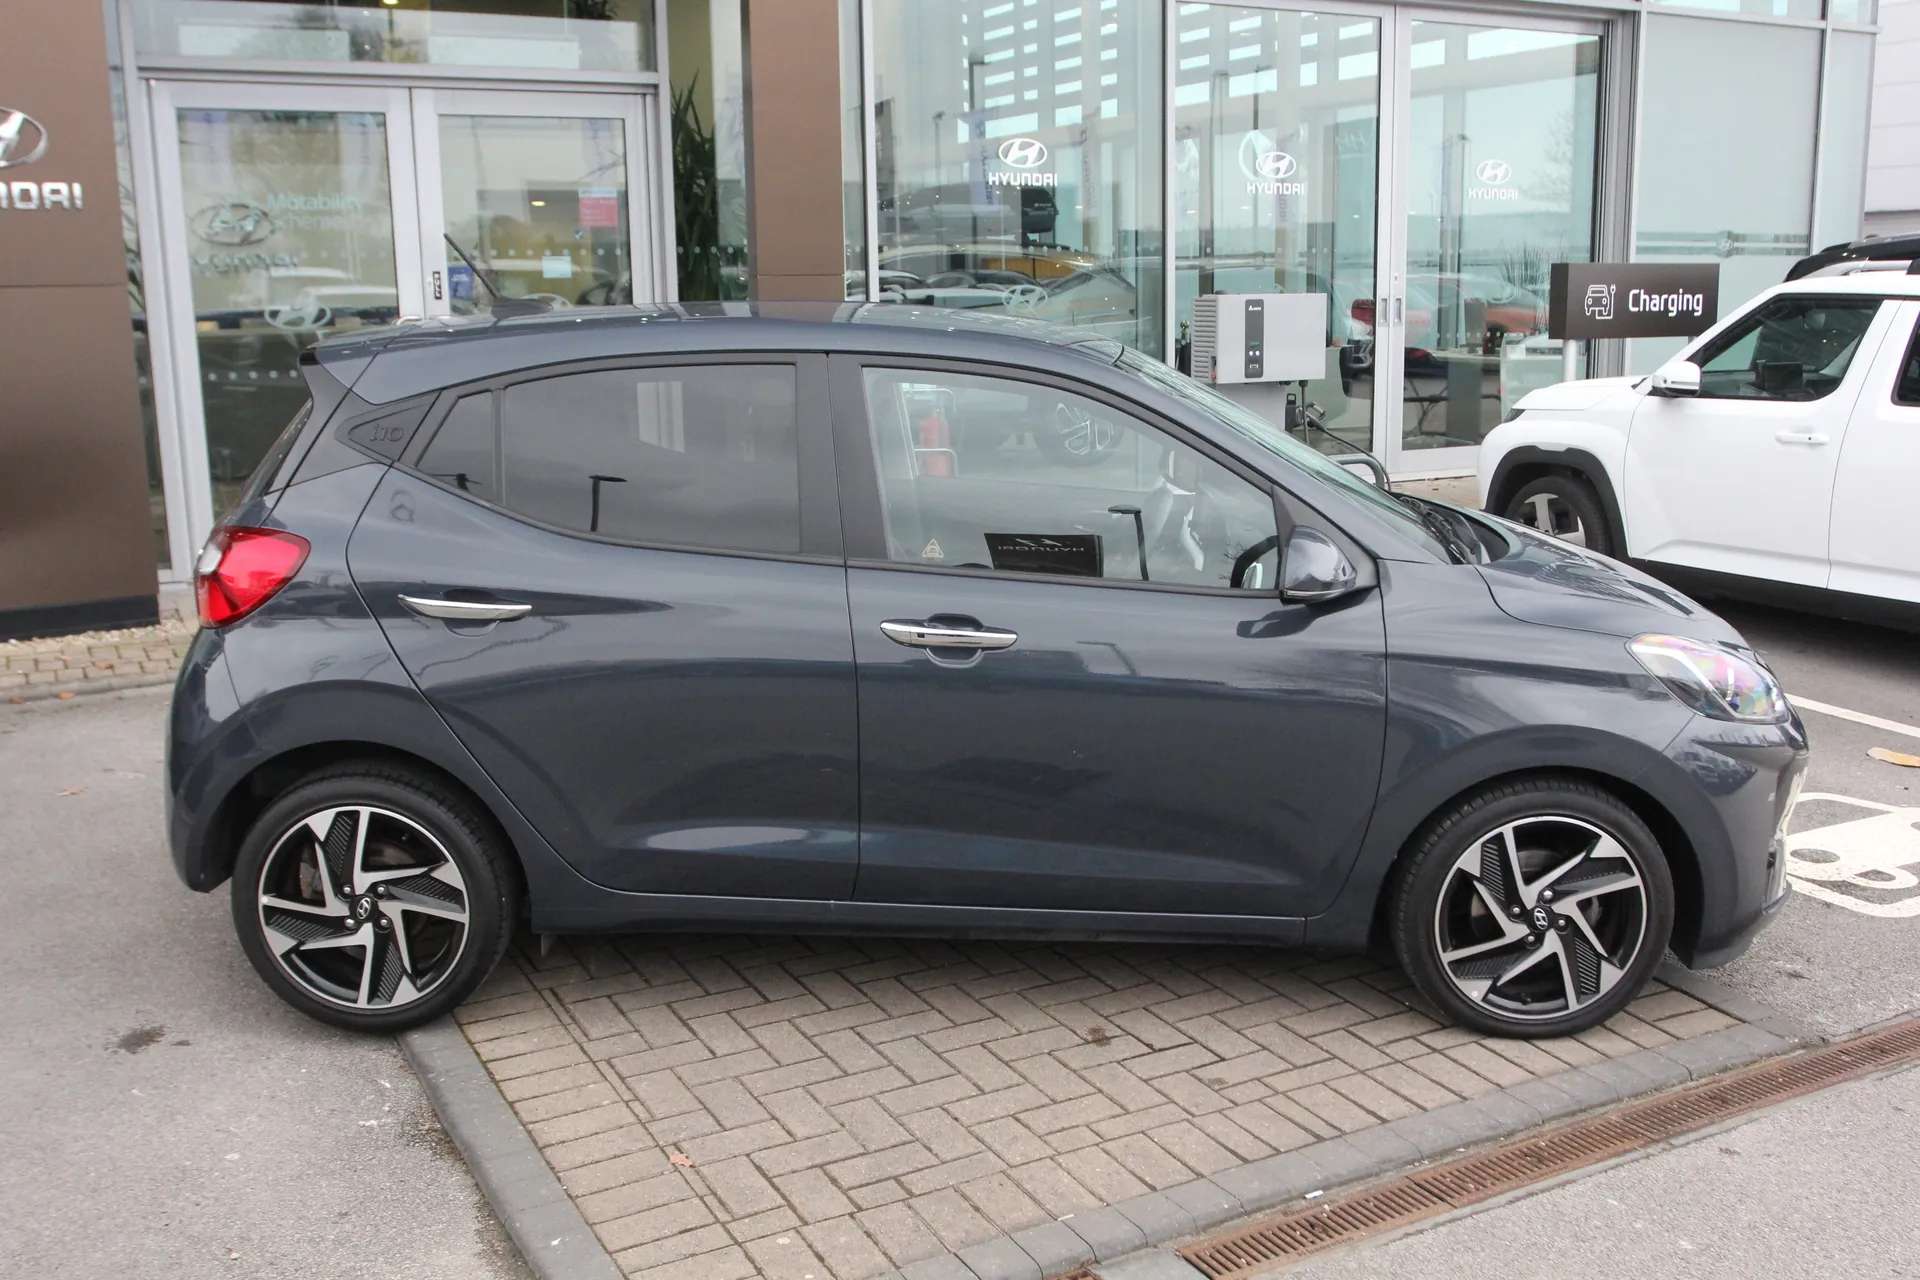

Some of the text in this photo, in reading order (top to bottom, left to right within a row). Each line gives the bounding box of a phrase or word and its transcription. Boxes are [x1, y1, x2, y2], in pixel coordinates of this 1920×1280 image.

[988, 172, 1058, 187] HYUNDAI
[1246, 182, 1304, 195] HYUNDAI
[1468, 187, 1519, 200] HYUNDAI
[1628, 288, 1703, 317] Charging
